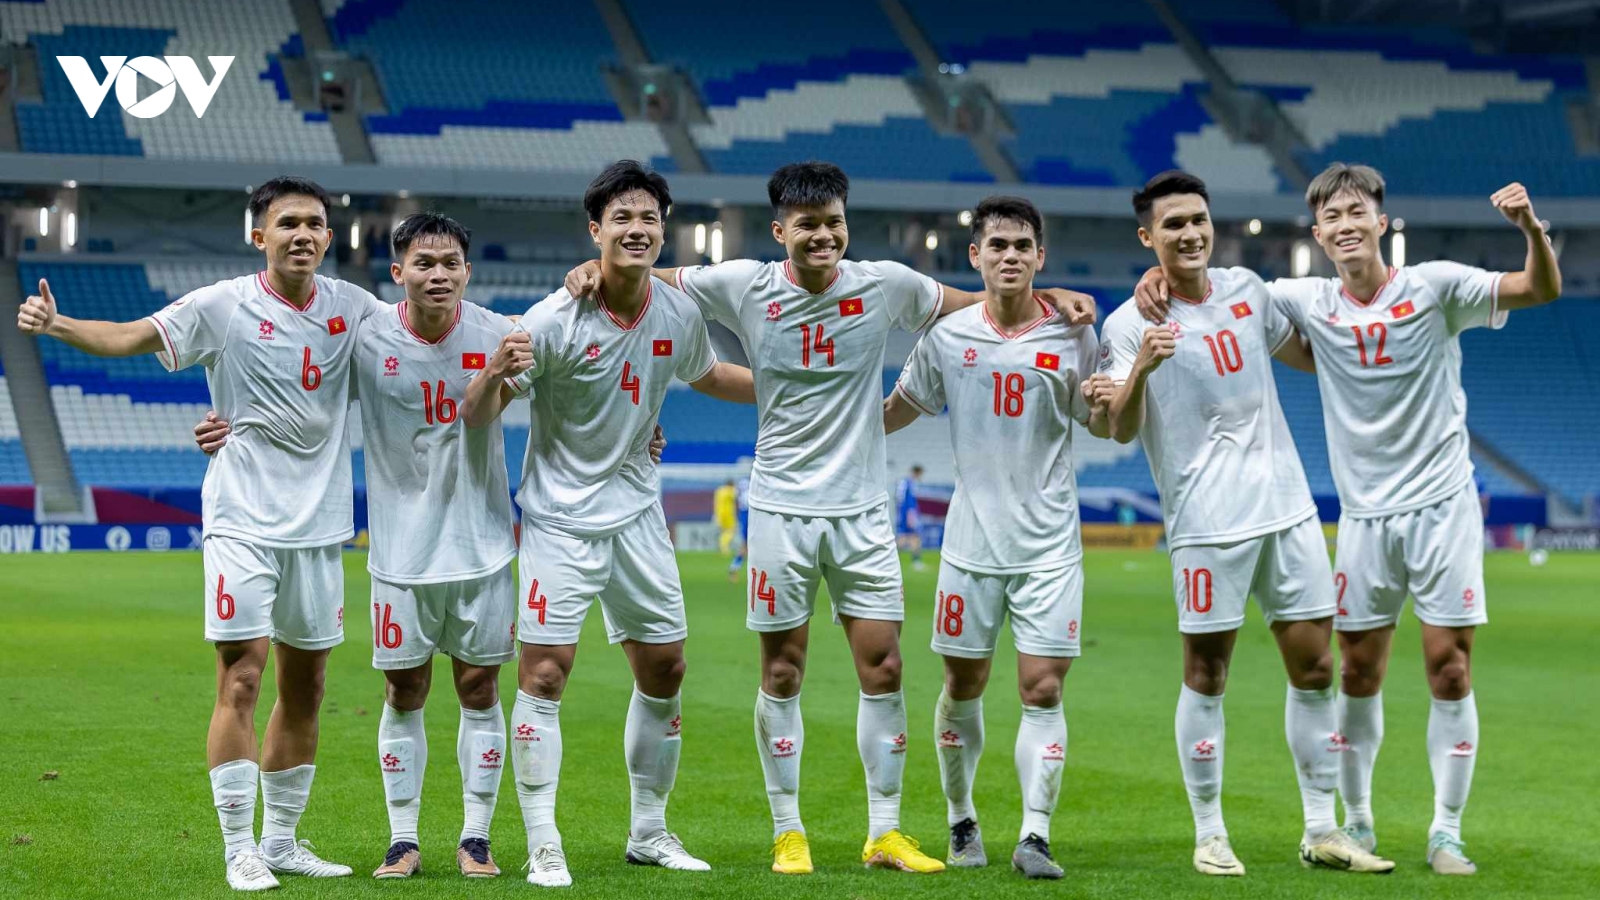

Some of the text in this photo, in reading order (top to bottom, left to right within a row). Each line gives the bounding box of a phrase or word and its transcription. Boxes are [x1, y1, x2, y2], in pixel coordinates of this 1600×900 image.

[800, 323, 835, 368] 14
[1203, 329, 1244, 377] 10
[1351, 322, 1393, 366] 12
[302, 346, 321, 391] 6
[621, 361, 640, 405] 4
[420, 380, 458, 425] 16
[992, 371, 1025, 418] 18
[41, 525, 71, 552] US
[216, 574, 236, 621] 6
[527, 579, 548, 625] 4
[750, 567, 776, 616] 14
[1183, 568, 1212, 613] 10
[1334, 571, 1348, 616] 2
[374, 602, 403, 649] 16
[936, 590, 965, 637] 18
